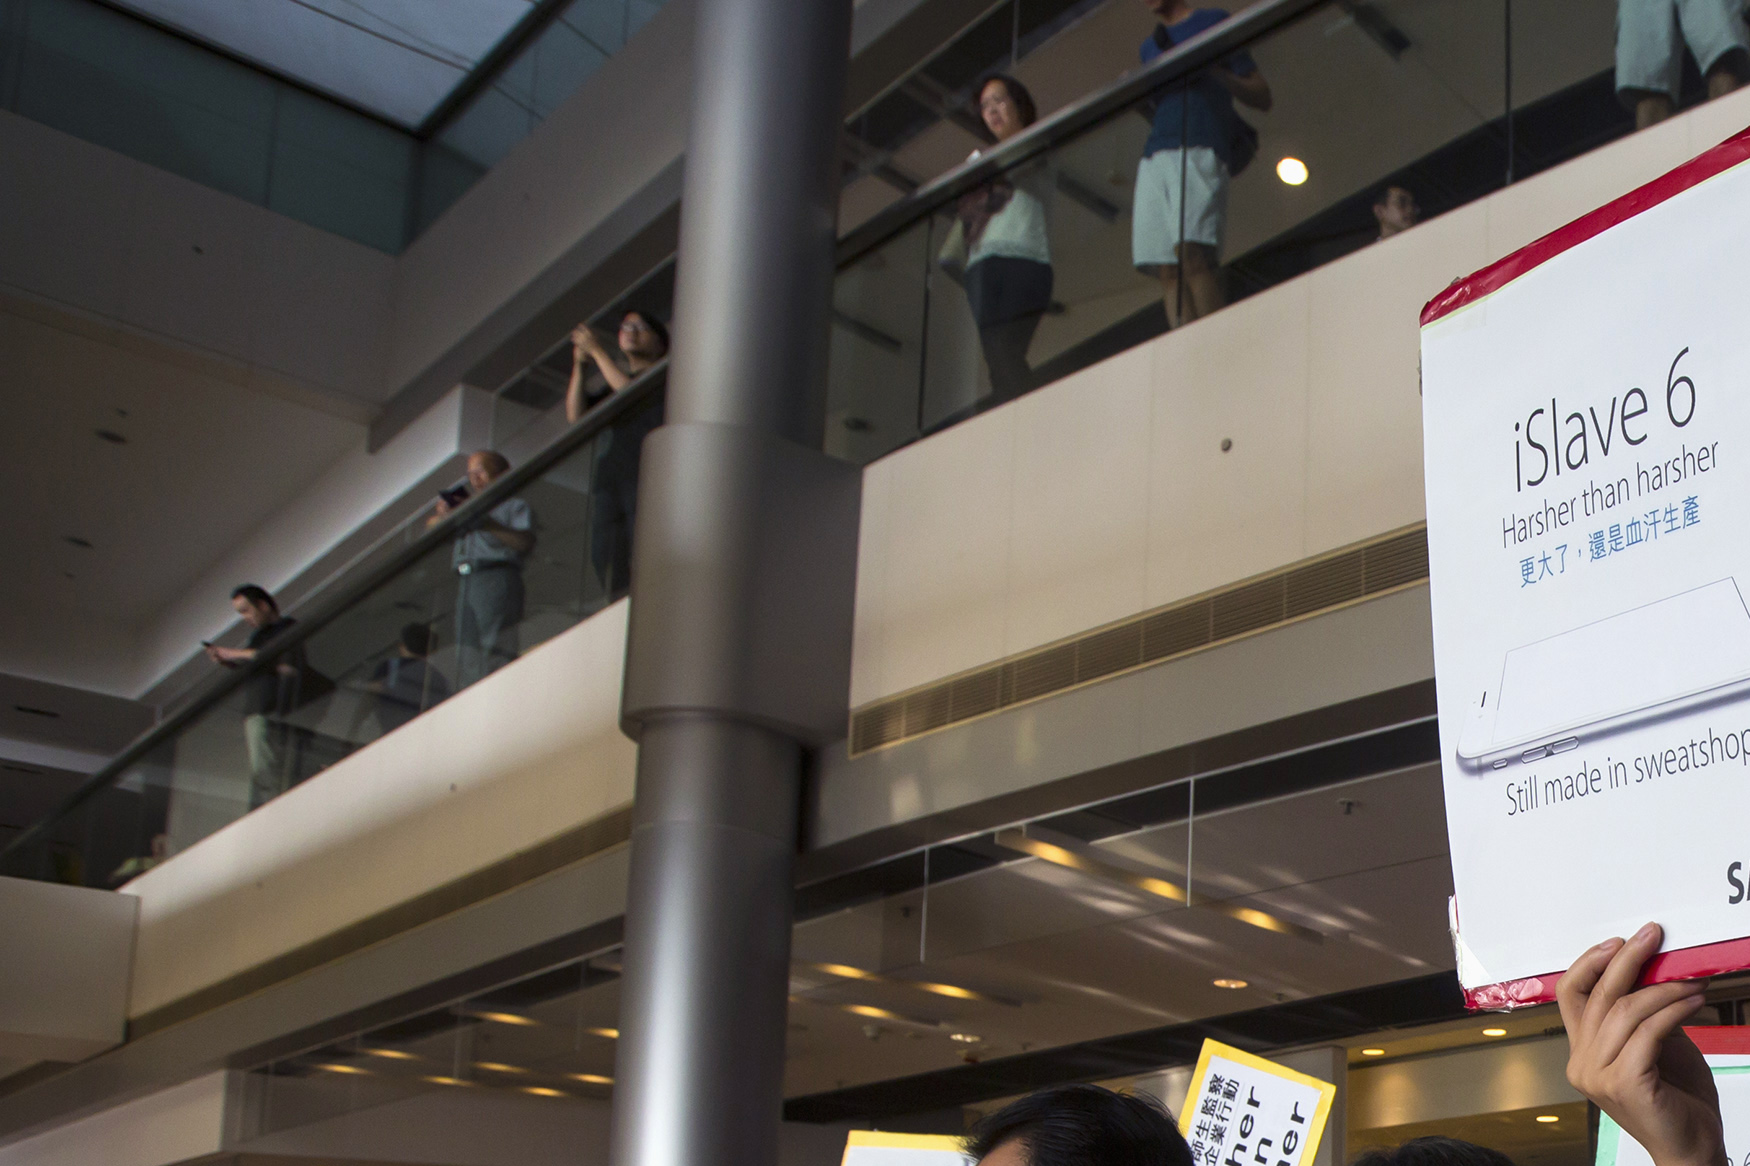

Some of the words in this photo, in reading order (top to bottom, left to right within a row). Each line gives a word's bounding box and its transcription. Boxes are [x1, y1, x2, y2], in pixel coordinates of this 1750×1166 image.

[1514, 387, 1648, 492] iSlave
[1666, 346, 1696, 428] 6
[1502, 497, 1577, 549] Harsher
[1582, 476, 1630, 517] than
[1636, 441, 1719, 497] harsher
[1506, 774, 1538, 816] Still
[1544, 760, 1602, 806] made
[1607, 756, 1628, 790] in
[1190, 1073, 1225, 1163] 師生監察
